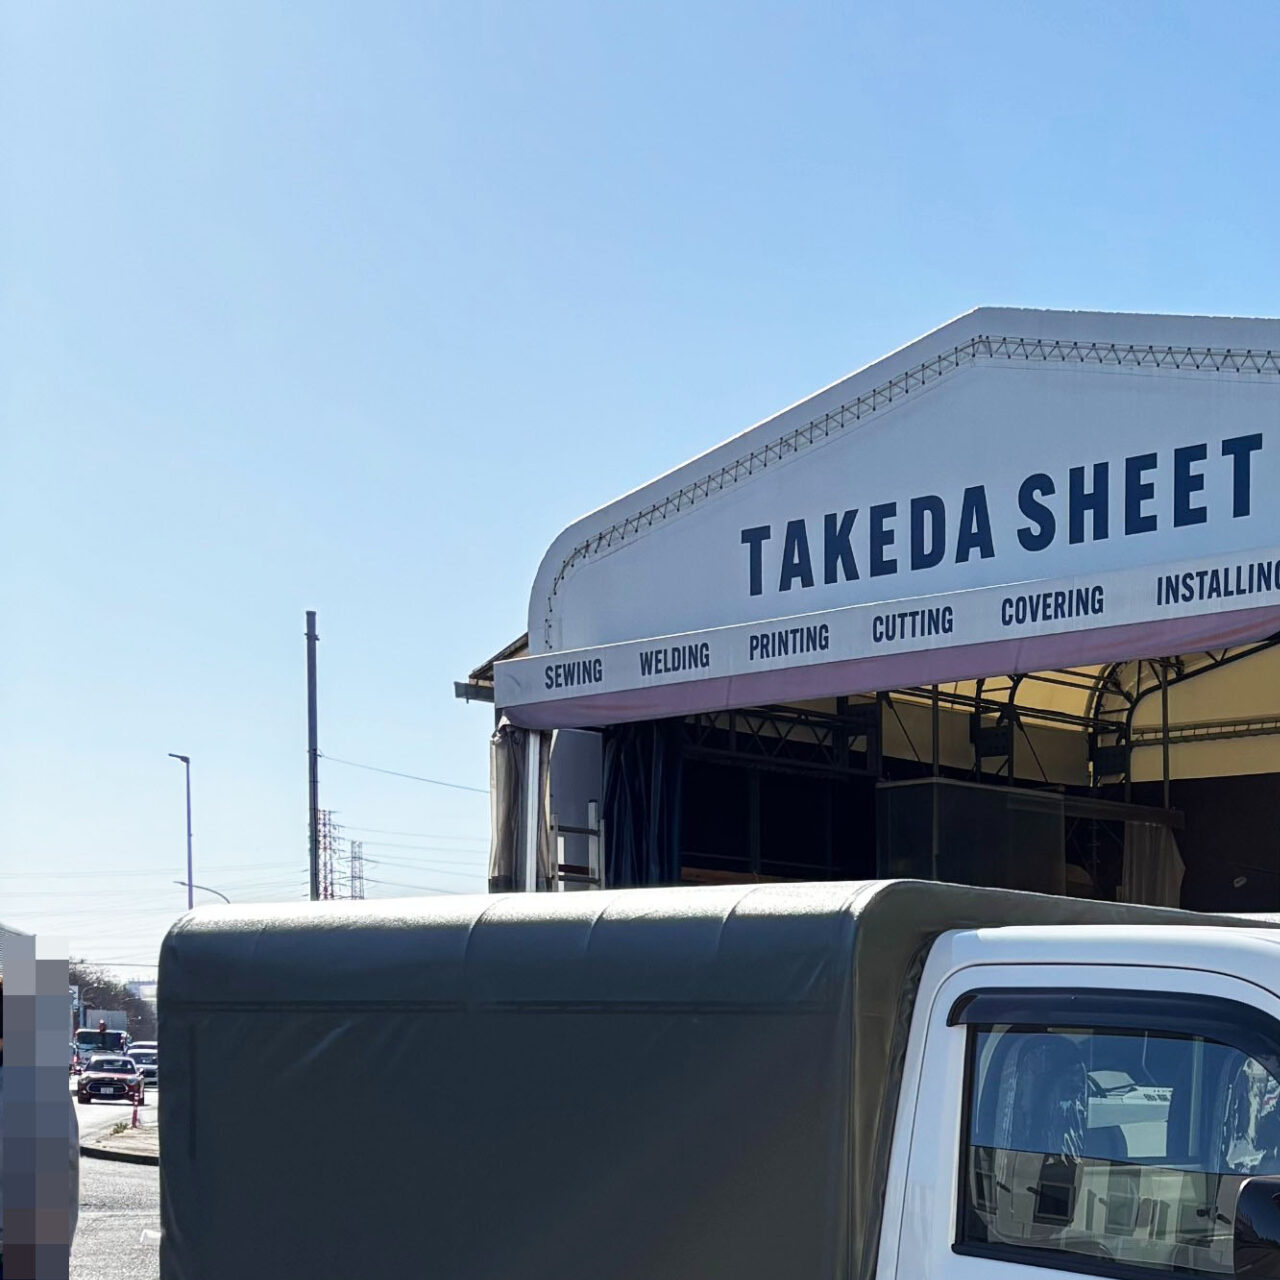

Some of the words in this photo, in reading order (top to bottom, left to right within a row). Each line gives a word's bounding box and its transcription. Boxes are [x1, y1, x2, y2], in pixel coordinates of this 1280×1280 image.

[741, 485, 995, 596] TAKEDA
[1017, 433, 1262, 551] SHEET
[545, 659, 603, 690] SEWING
[640, 643, 710, 677] WELDING
[750, 624, 830, 661] PRINTING
[873, 606, 953, 642] CUTTING
[1002, 586, 1104, 626] COVERING
